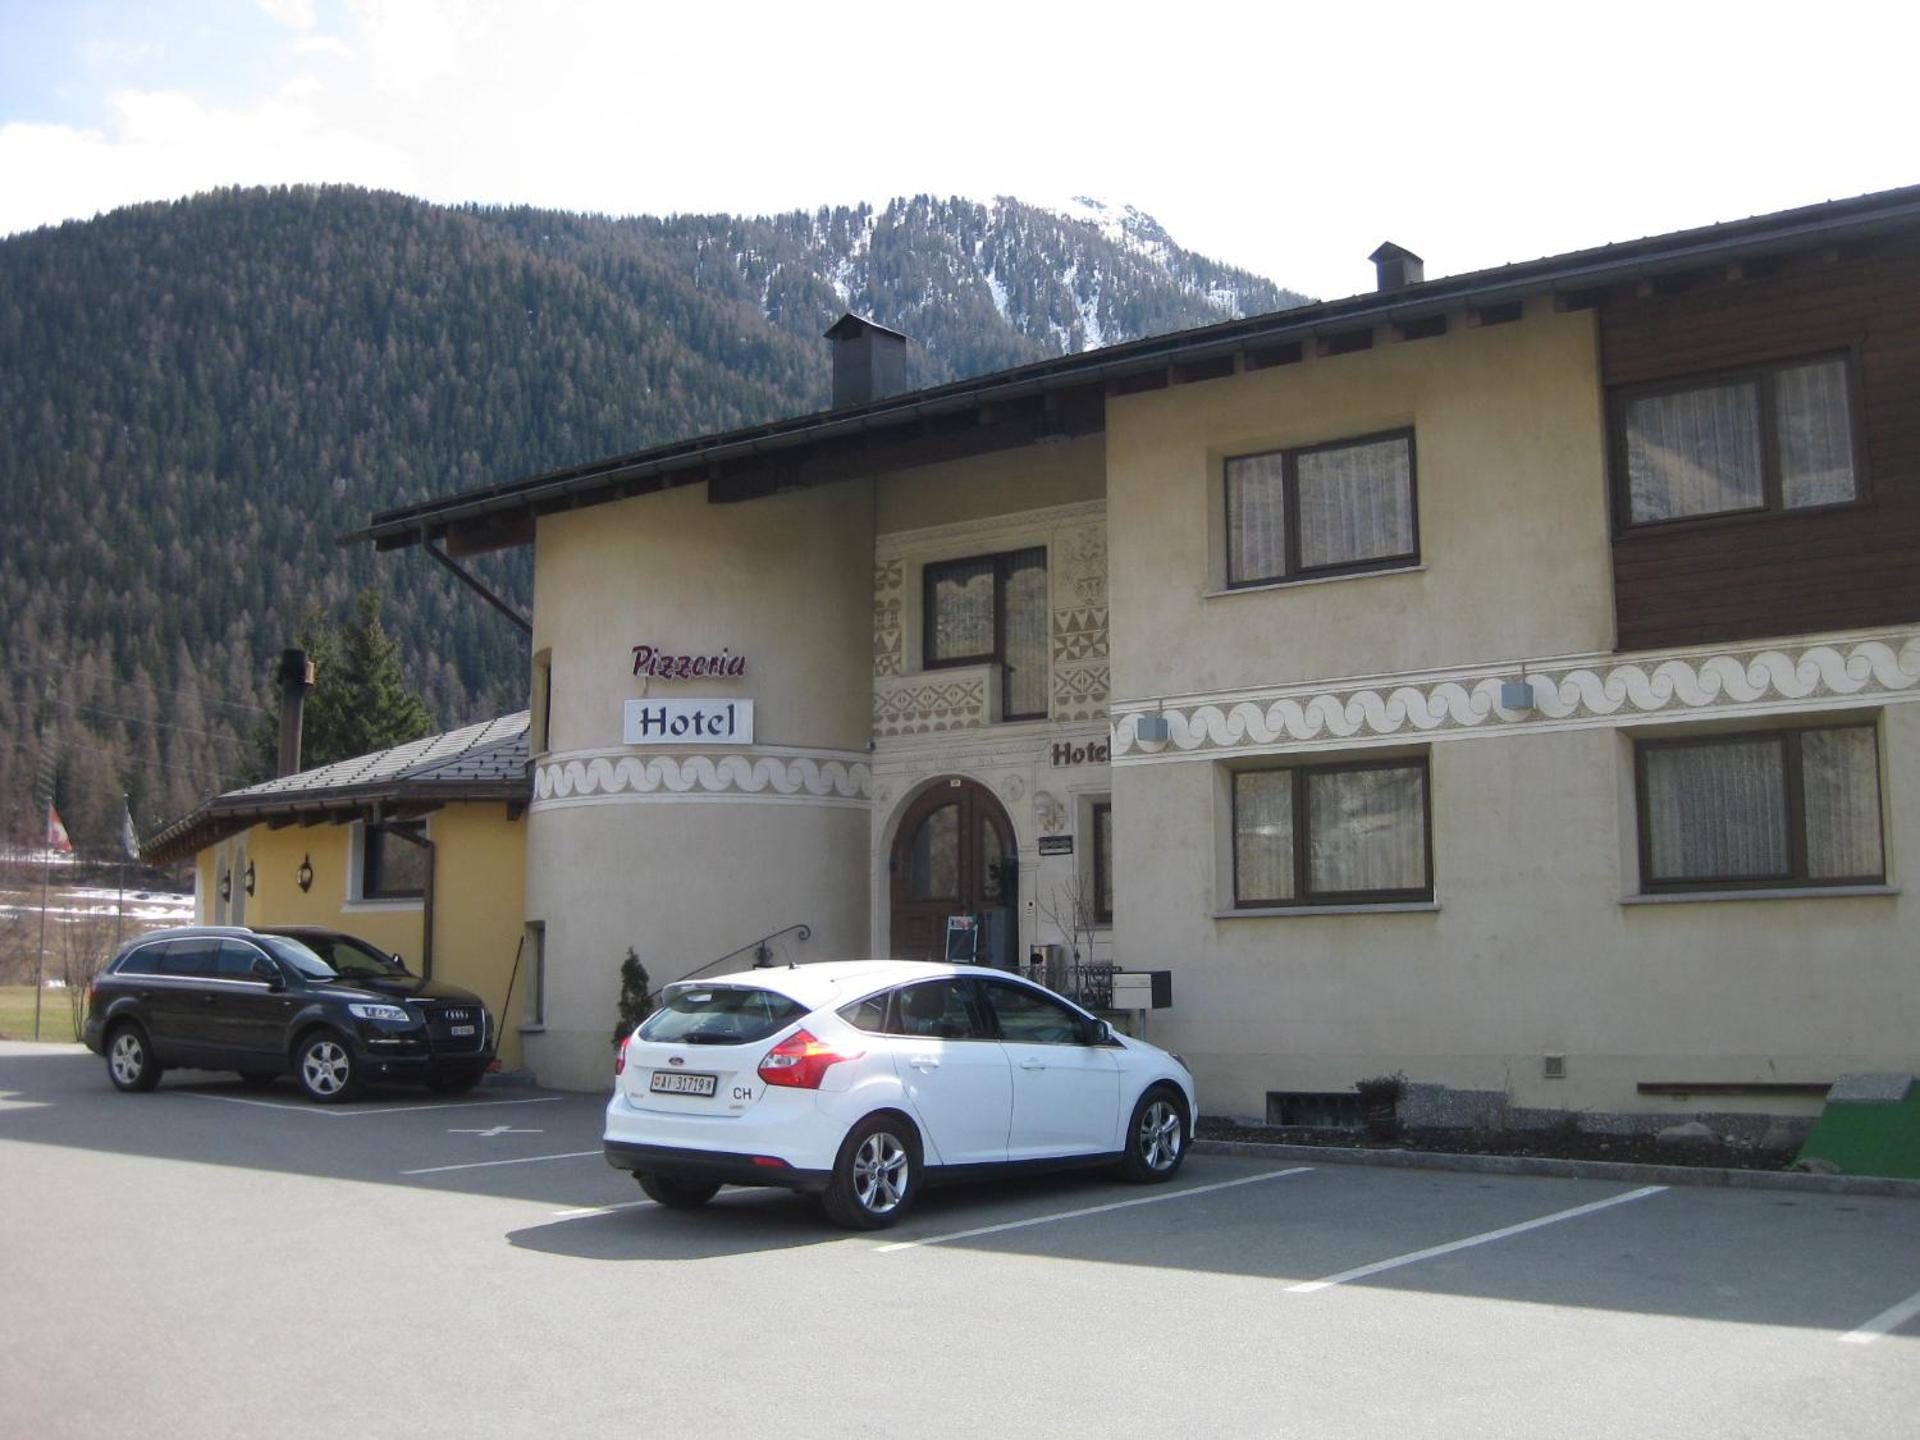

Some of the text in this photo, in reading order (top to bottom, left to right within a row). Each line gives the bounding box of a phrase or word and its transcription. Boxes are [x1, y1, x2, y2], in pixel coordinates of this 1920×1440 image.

[632, 645, 746, 679] Pizzeria
[640, 703, 735, 737] Hotel
[733, 1087, 752, 1100] CH
